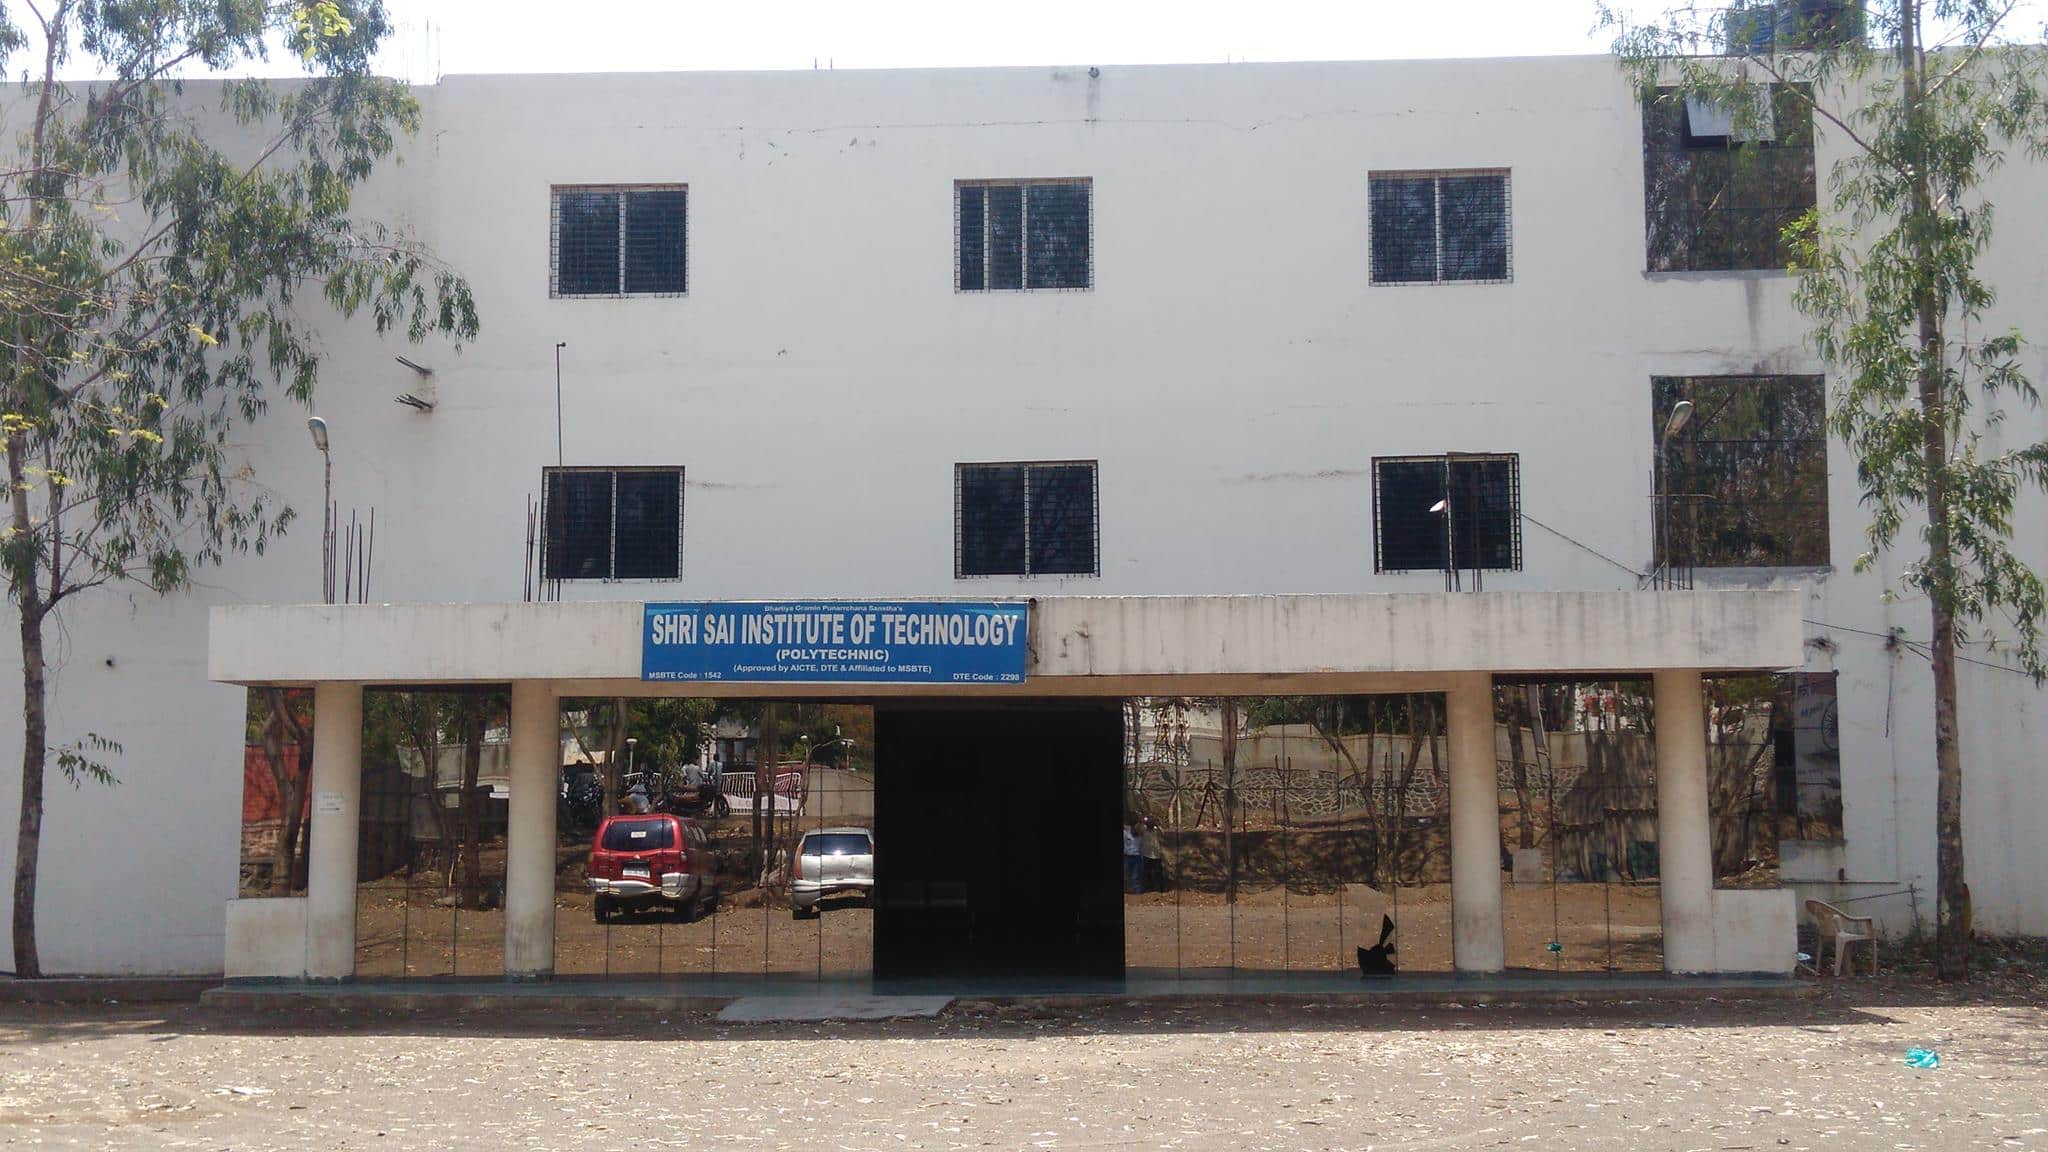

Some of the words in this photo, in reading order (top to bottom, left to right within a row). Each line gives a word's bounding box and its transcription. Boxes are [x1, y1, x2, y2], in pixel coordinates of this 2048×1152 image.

[652, 614, 698, 645] SHRI
[703, 614, 735, 645] SAI
[741, 613, 844, 645] INSTITUTE
[850, 613, 876, 645] OF
[882, 614, 1018, 646] TECHNOLOGY
[776, 649, 890, 663] (POLYTECHNIC)
[733, 664, 777, 673] (Approved
[778, 664, 790, 673] by
[790, 664, 819, 673] AICTE,
[821, 664, 838, 672] DTE
[840, 664, 847, 672] &
[848, 664, 886, 673] Affiliated
[887, 665, 897, 673] to
[898, 665, 933, 674] MSBTE)
[677, 671, 698, 679] Code
[703, 671, 722, 679] 1542
[952, 673, 970, 681] DTE
[971, 673, 994, 681] Code
